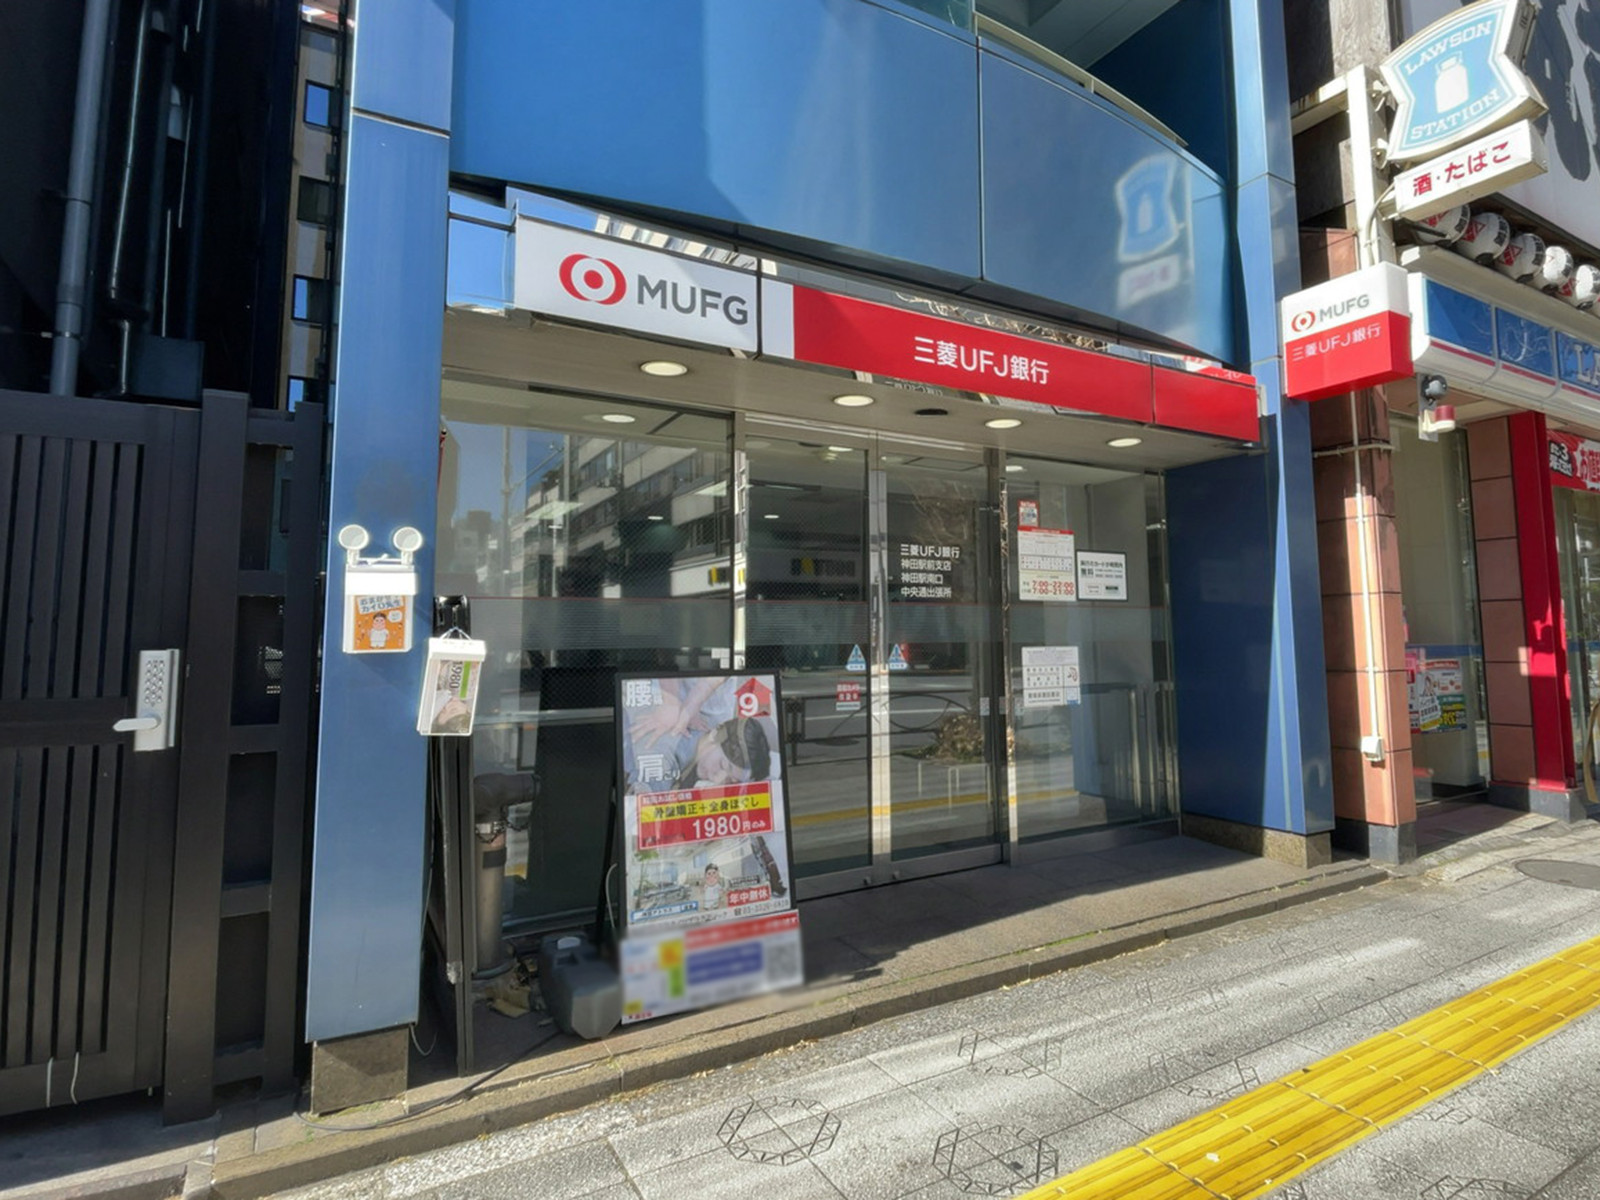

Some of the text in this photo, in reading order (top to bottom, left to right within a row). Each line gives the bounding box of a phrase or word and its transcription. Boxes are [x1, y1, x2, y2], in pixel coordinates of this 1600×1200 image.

[1404, 20, 1493, 76] LAWSON
[1410, 88, 1500, 140] STATION
[1413, 141, 1511, 197] 酒・たばこ
[637, 273, 748, 326] MUFG
[1319, 294, 1370, 322] MUFG
[913, 336, 1050, 385] 三菱UFJ銀行
[1292, 322, 1382, 362] 三菱UFJ銀行
[900, 543, 960, 559] 三菱UFJ銀行
[738, 692, 760, 717] 9
[637, 753, 681, 783] 肩こり
